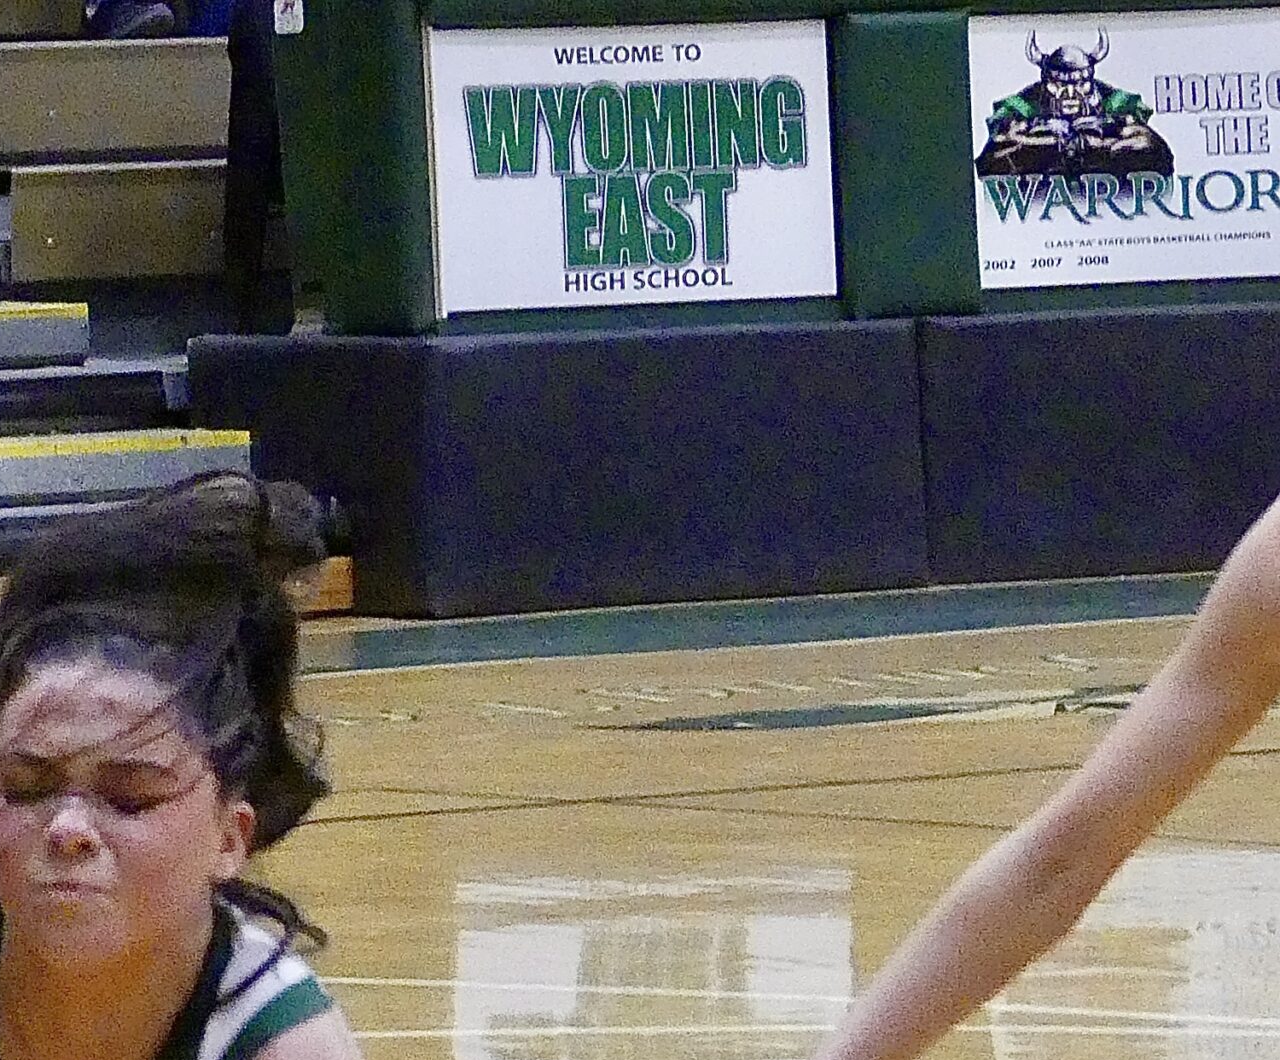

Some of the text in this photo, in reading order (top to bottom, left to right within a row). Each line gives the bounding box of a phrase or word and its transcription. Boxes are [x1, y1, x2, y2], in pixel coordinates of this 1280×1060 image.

[553, 43, 702, 66] WELCOME TO
[1154, 71, 1263, 114] HOME
[462, 75, 808, 180] WYOMING
[1198, 115, 1271, 156] THE
[979, 169, 1280, 225] WARRIOR
[562, 170, 738, 271] EAST
[1152, 233, 1210, 245] BASKETBALL
[1213, 230, 1272, 243] CHAMPIONS
[563, 267, 734, 293] HIGH SCHOOL
[983, 259, 1017, 271] 2002
[1030, 257, 1063, 269] 2007
